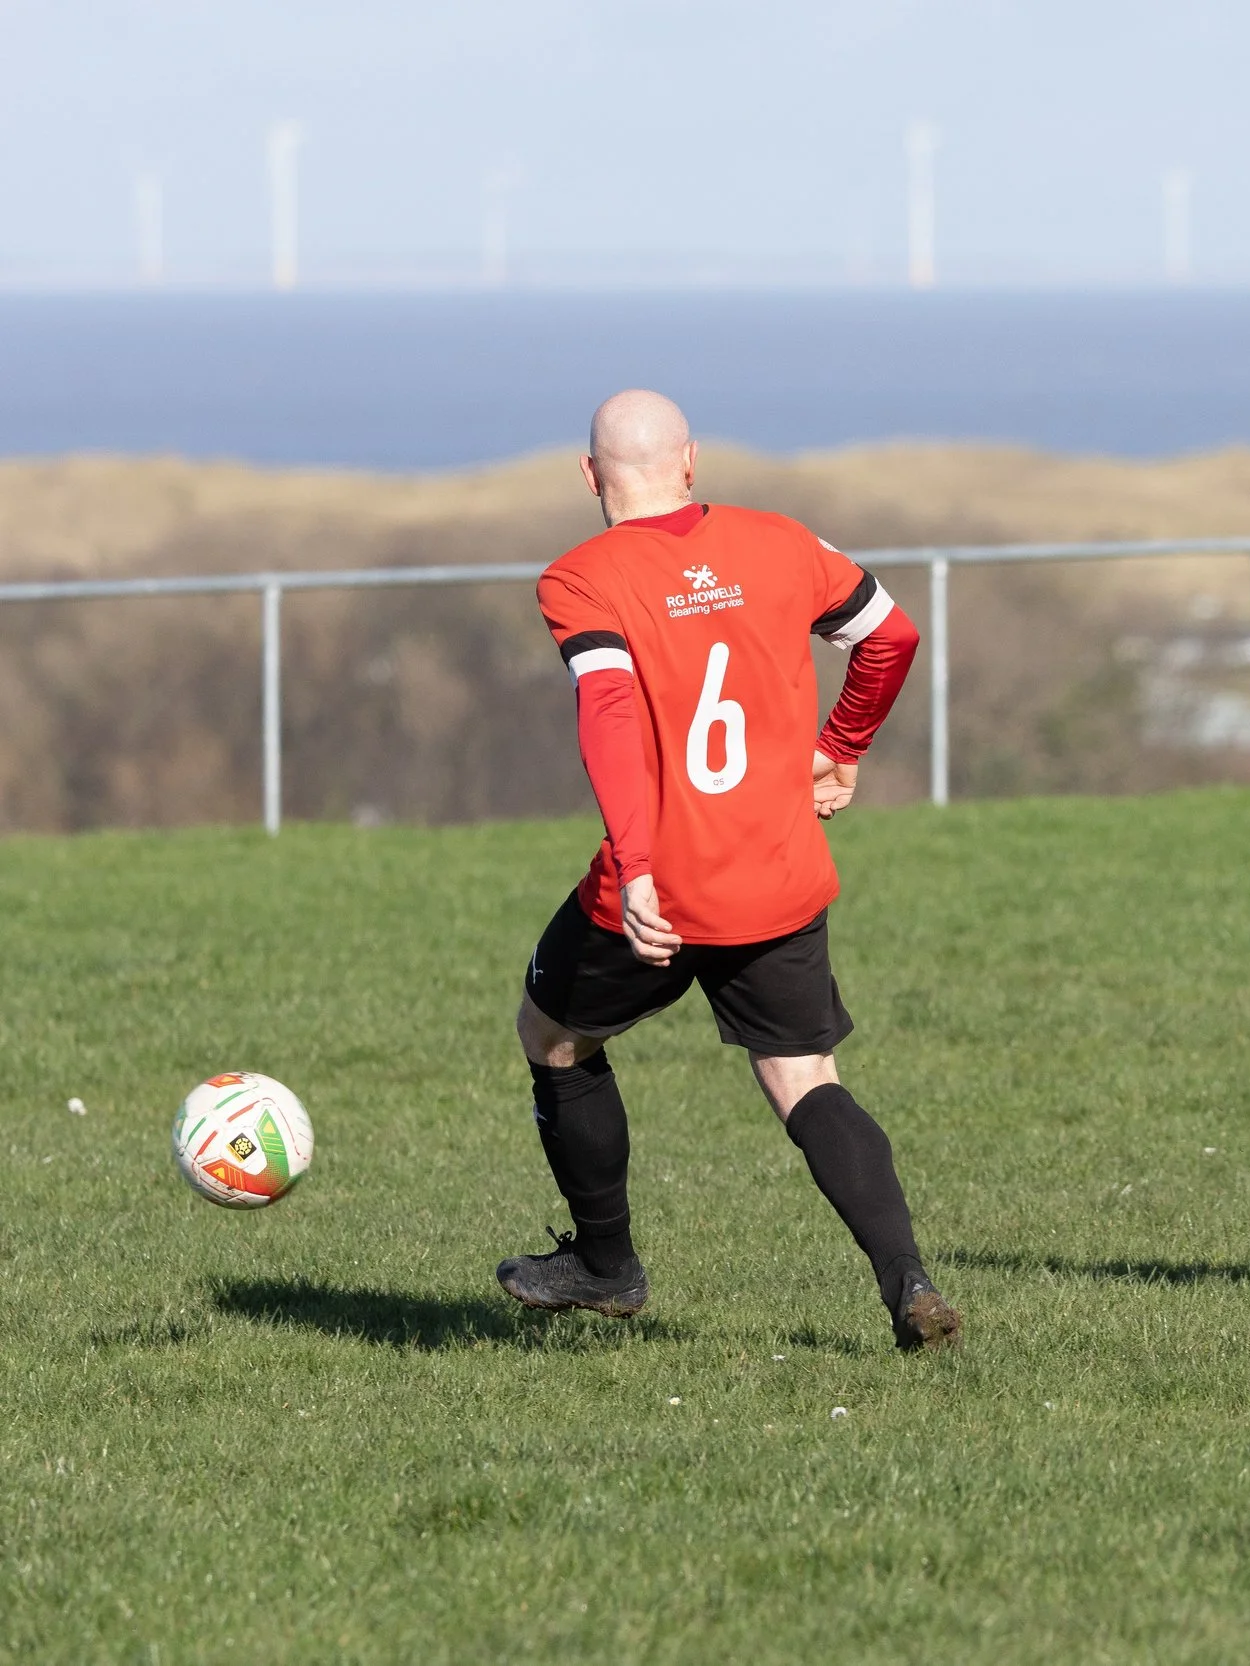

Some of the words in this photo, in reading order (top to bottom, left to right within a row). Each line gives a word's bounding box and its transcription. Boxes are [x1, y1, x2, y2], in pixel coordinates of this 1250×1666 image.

[665, 595, 686, 608] RG
[687, 584, 742, 604] HOWELLS
[669, 604, 710, 618] cleaning
[712, 597, 745, 611] services
[686, 641, 747, 794] 6
